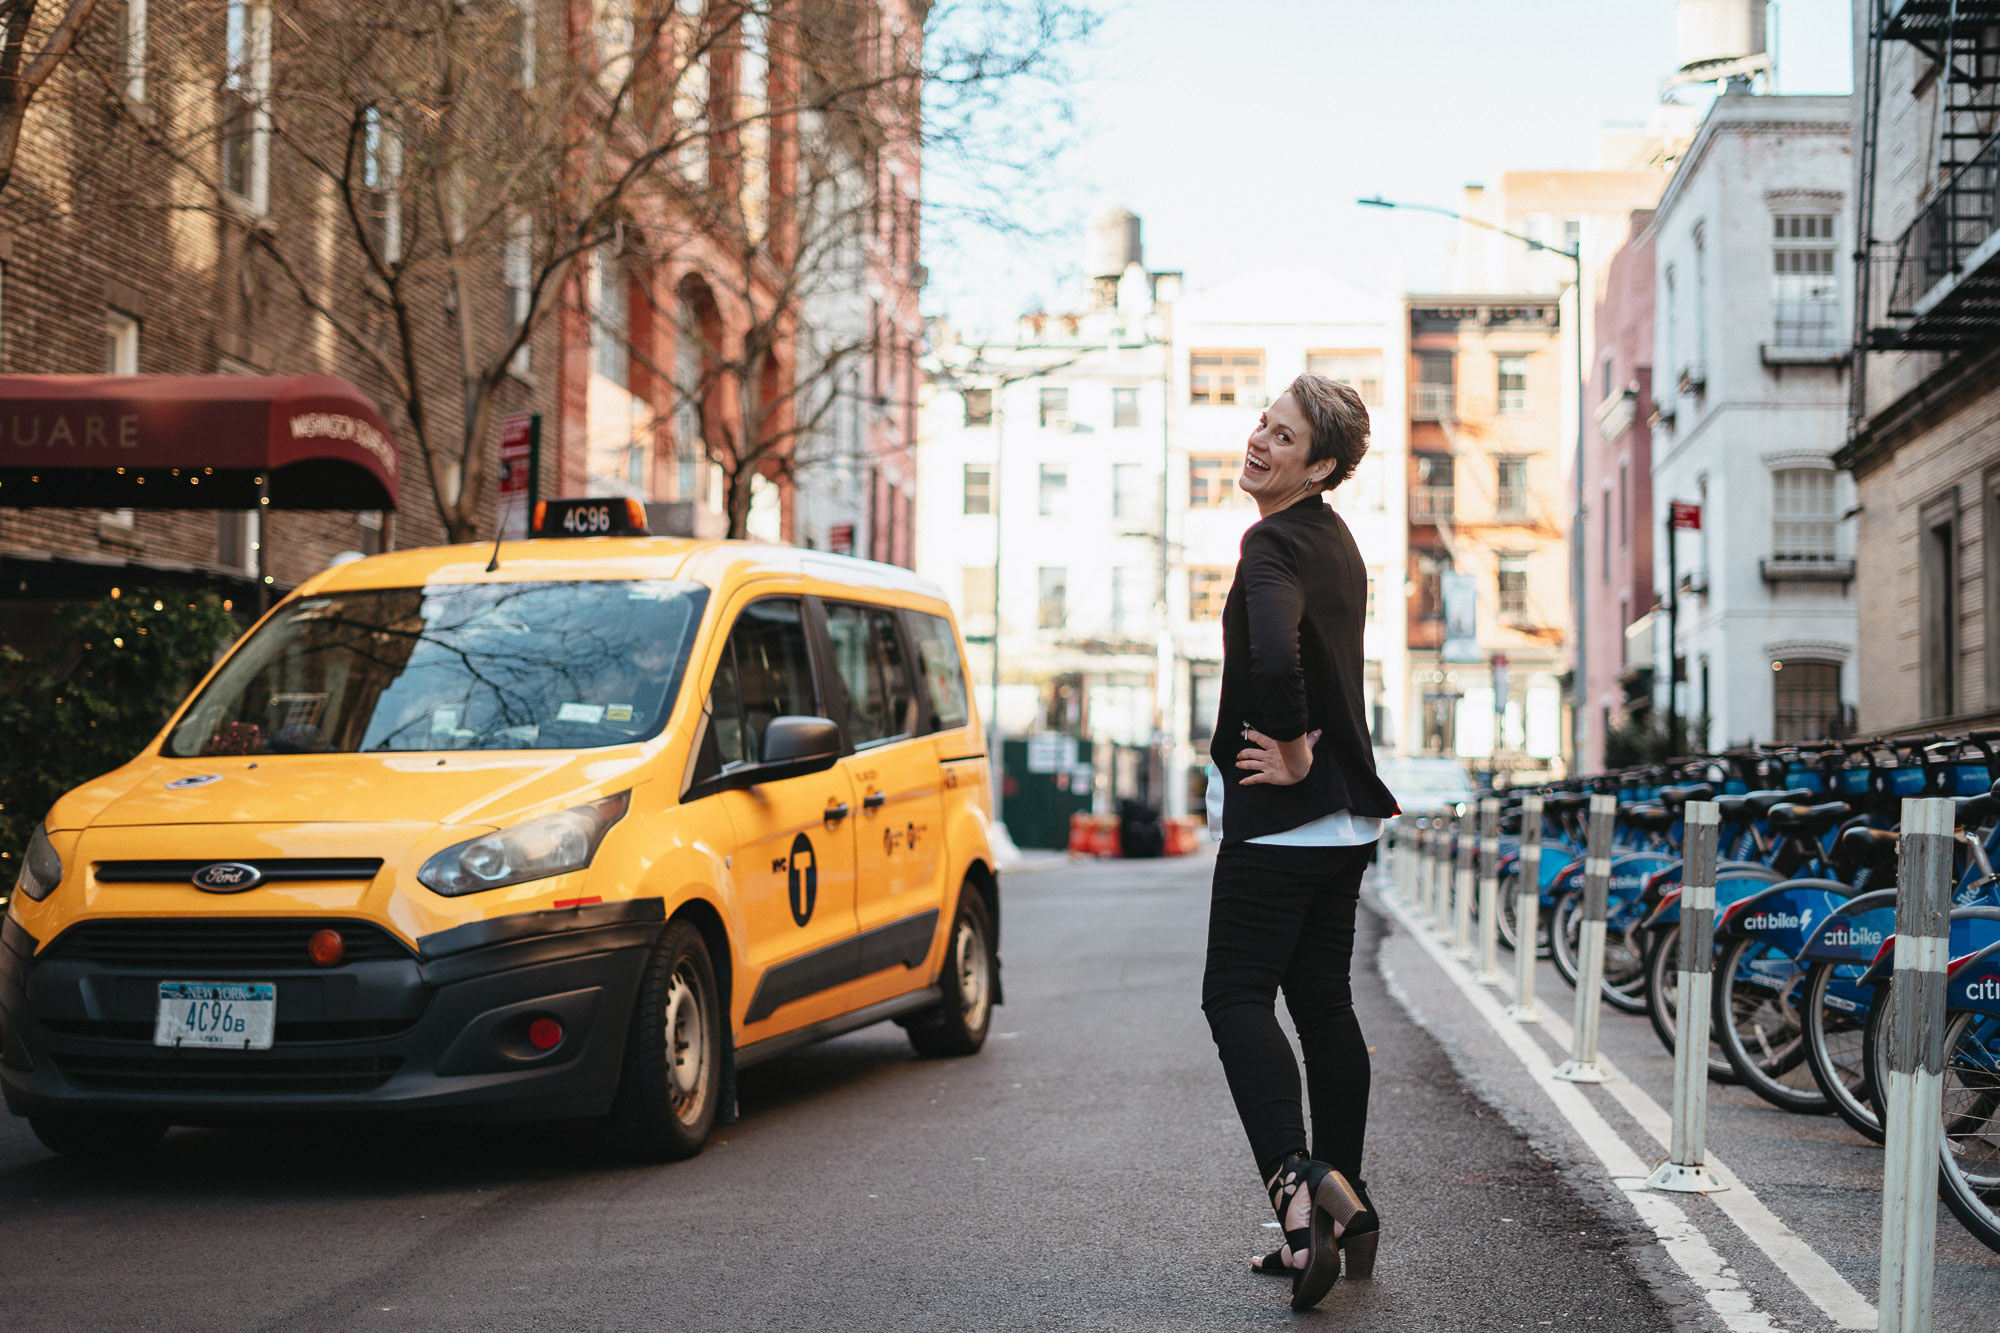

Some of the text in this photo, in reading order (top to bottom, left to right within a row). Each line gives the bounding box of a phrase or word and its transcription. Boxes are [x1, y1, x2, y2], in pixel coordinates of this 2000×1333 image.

[0, 414, 139, 448] UARE
[563, 506, 610, 532] 4C96
[206, 866, 244, 883] Ford
[1744, 912, 1799, 930] citi bike
[1824, 926, 1882, 946] citi bike
[187, 986, 247, 1001] NEW YORK
[1966, 976, 2000, 1000] citi
[186, 1001, 246, 1033] 4C96B
